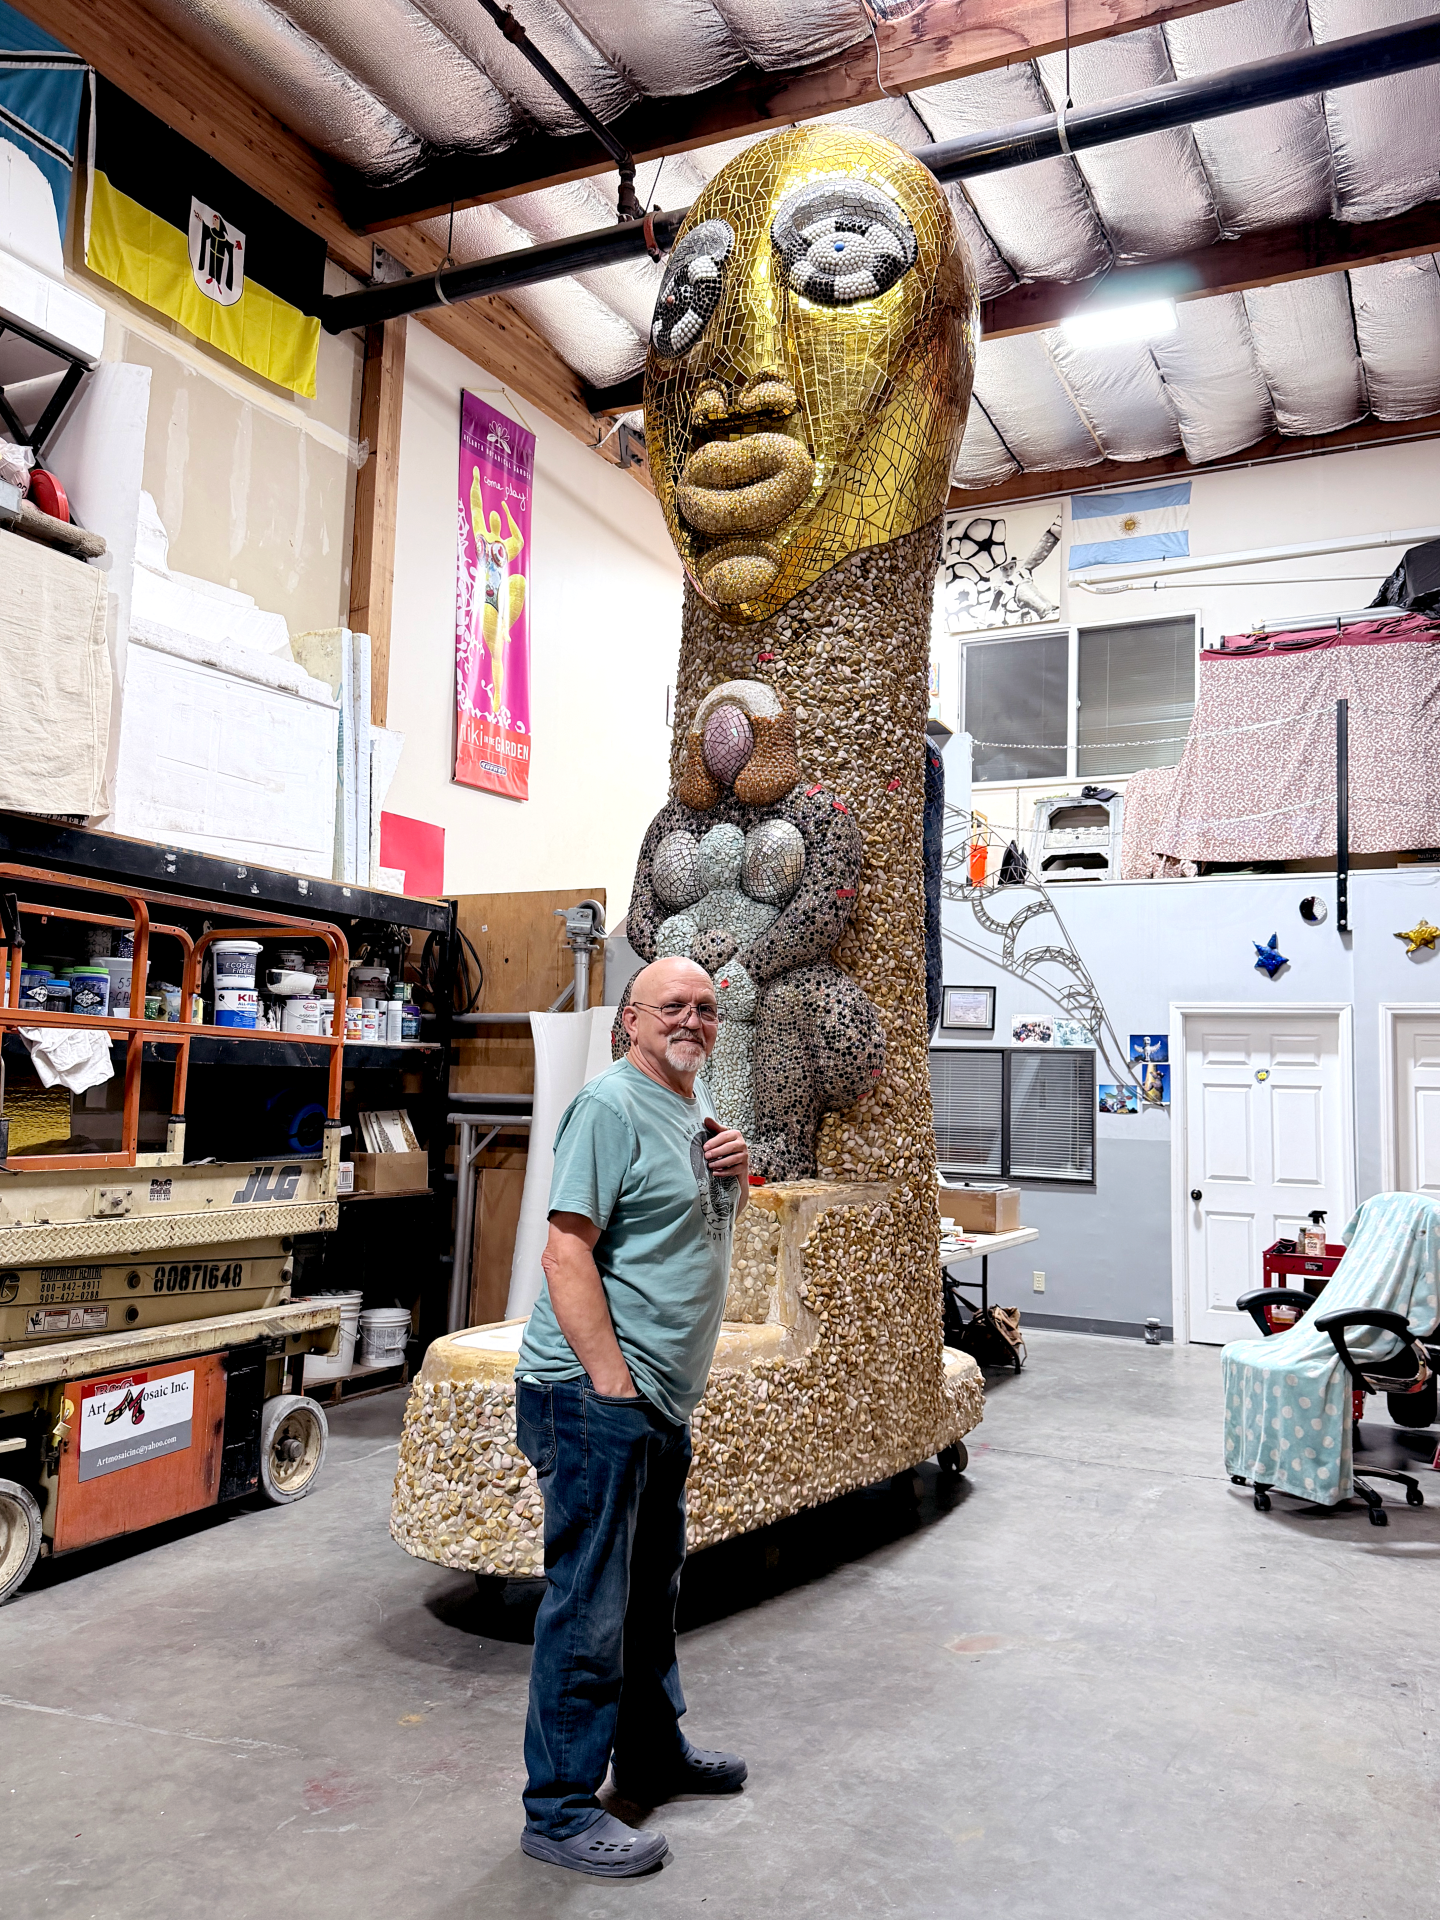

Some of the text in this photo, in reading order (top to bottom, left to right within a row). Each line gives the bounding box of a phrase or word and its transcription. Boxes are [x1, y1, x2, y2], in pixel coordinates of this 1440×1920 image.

[463, 433, 484, 451] ATLANTA
[484, 476, 529, 511] come play!
[495, 736, 529, 761] GARDEN
[232, 1165, 302, 1204] JLG
[41, 1281, 100, 1293] 800-842-8911
[153, 1263, 243, 1293] 80871648
[40, 1290, 99, 1303] 909-422-0288
[87, 1401, 107, 1418] Art
[170, 1381, 189, 1394] Inc.
[96, 1436, 177, 1468] Artmosaicinc@yahoo.com
